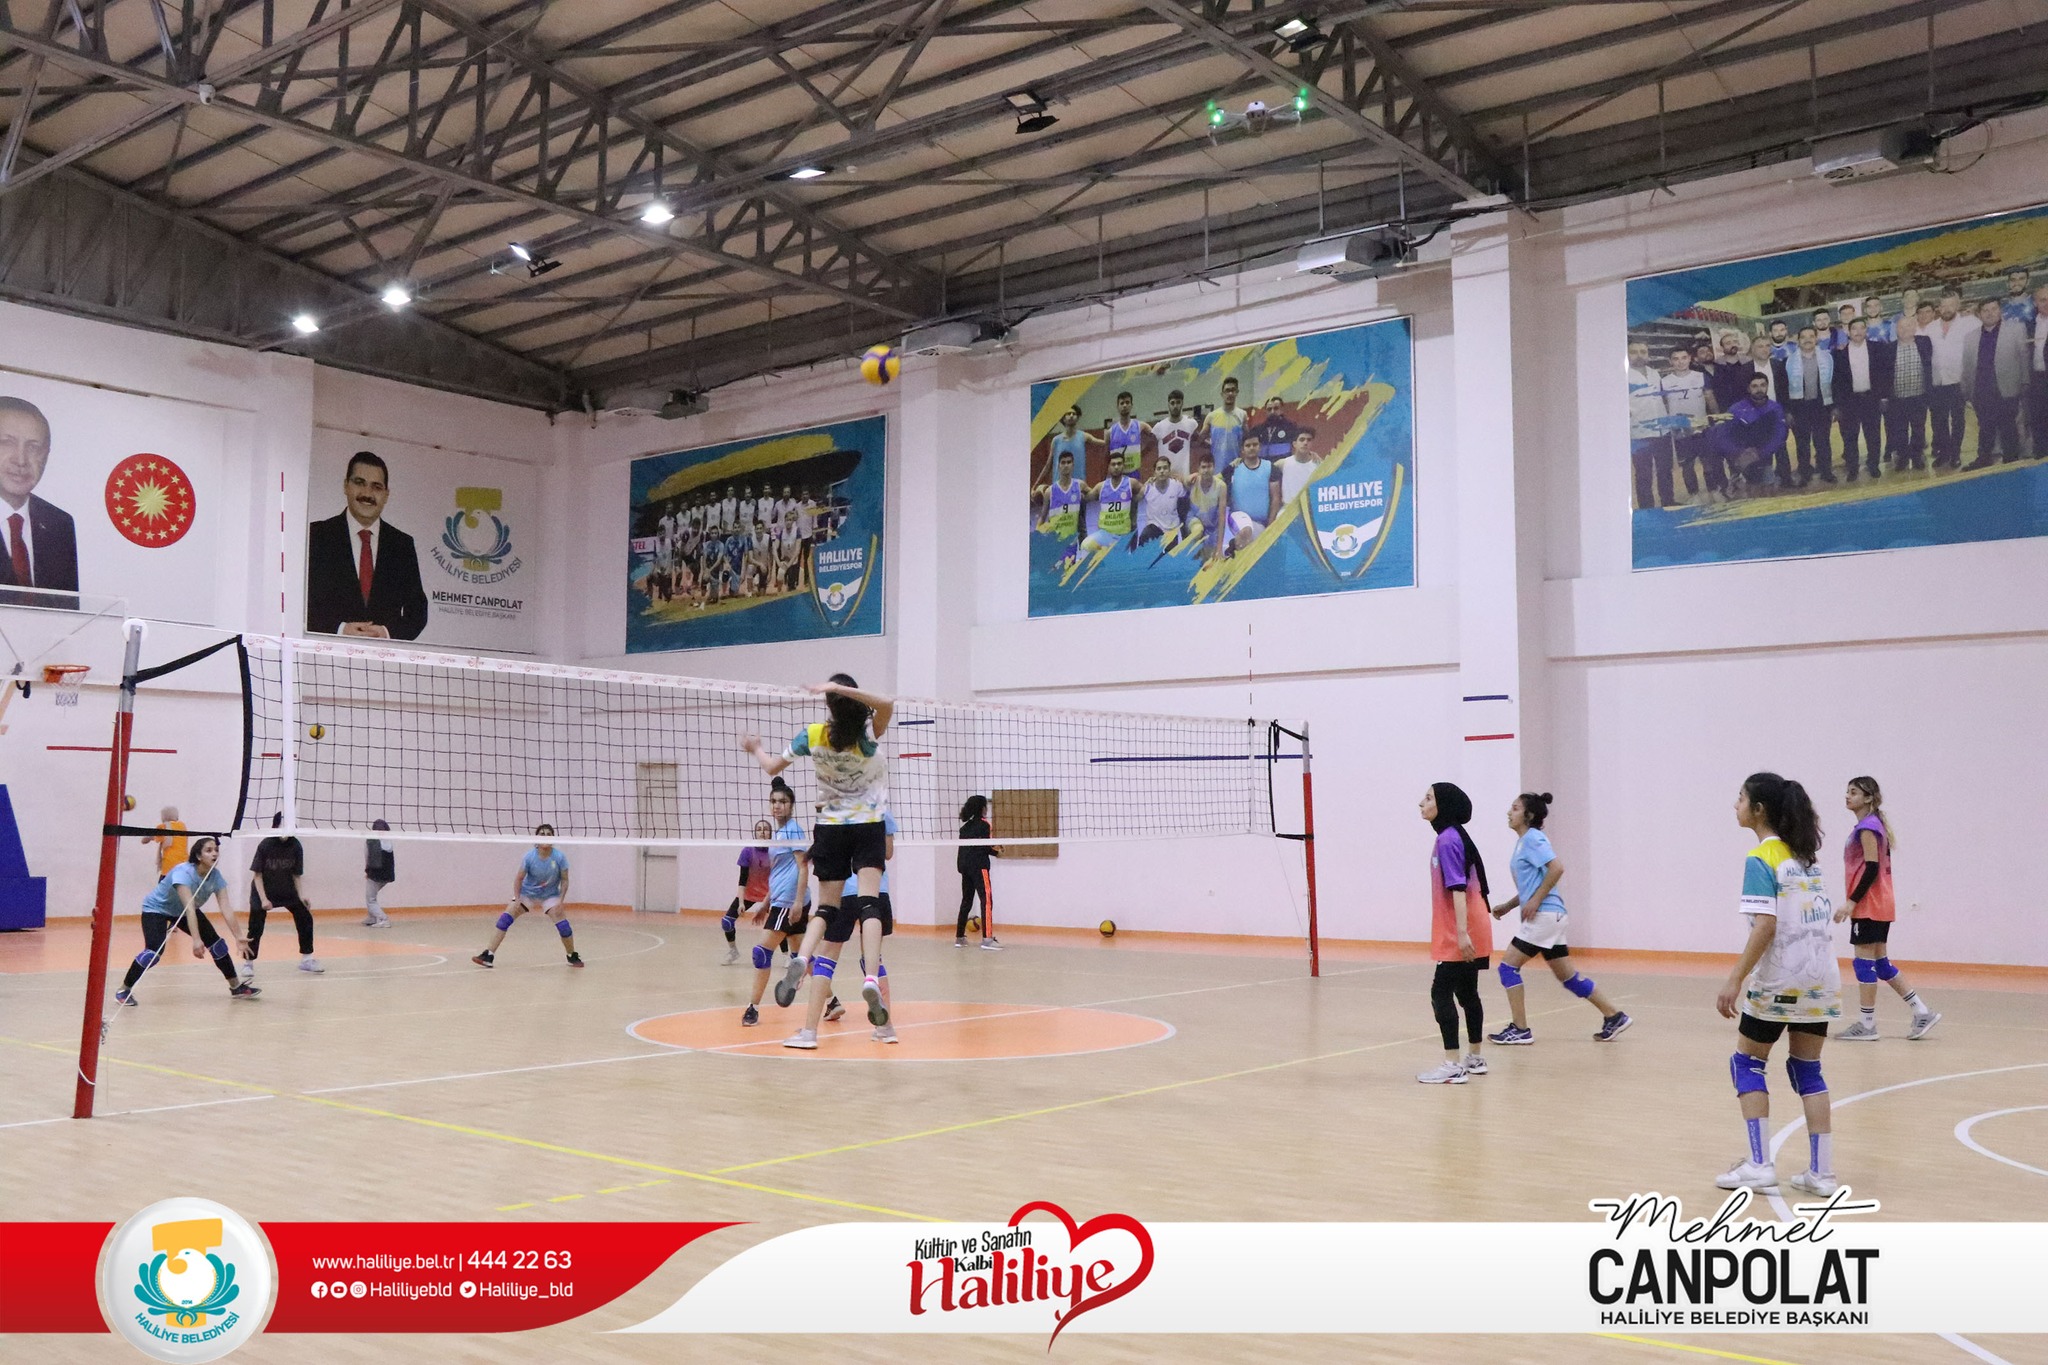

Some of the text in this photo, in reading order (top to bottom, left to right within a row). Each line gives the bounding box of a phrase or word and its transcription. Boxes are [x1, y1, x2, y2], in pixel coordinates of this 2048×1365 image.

[1108, 501, 1122, 513] 20
[432, 591, 523, 610] MEHMET CANPOLAT
[1853, 922, 1860, 937] 4
